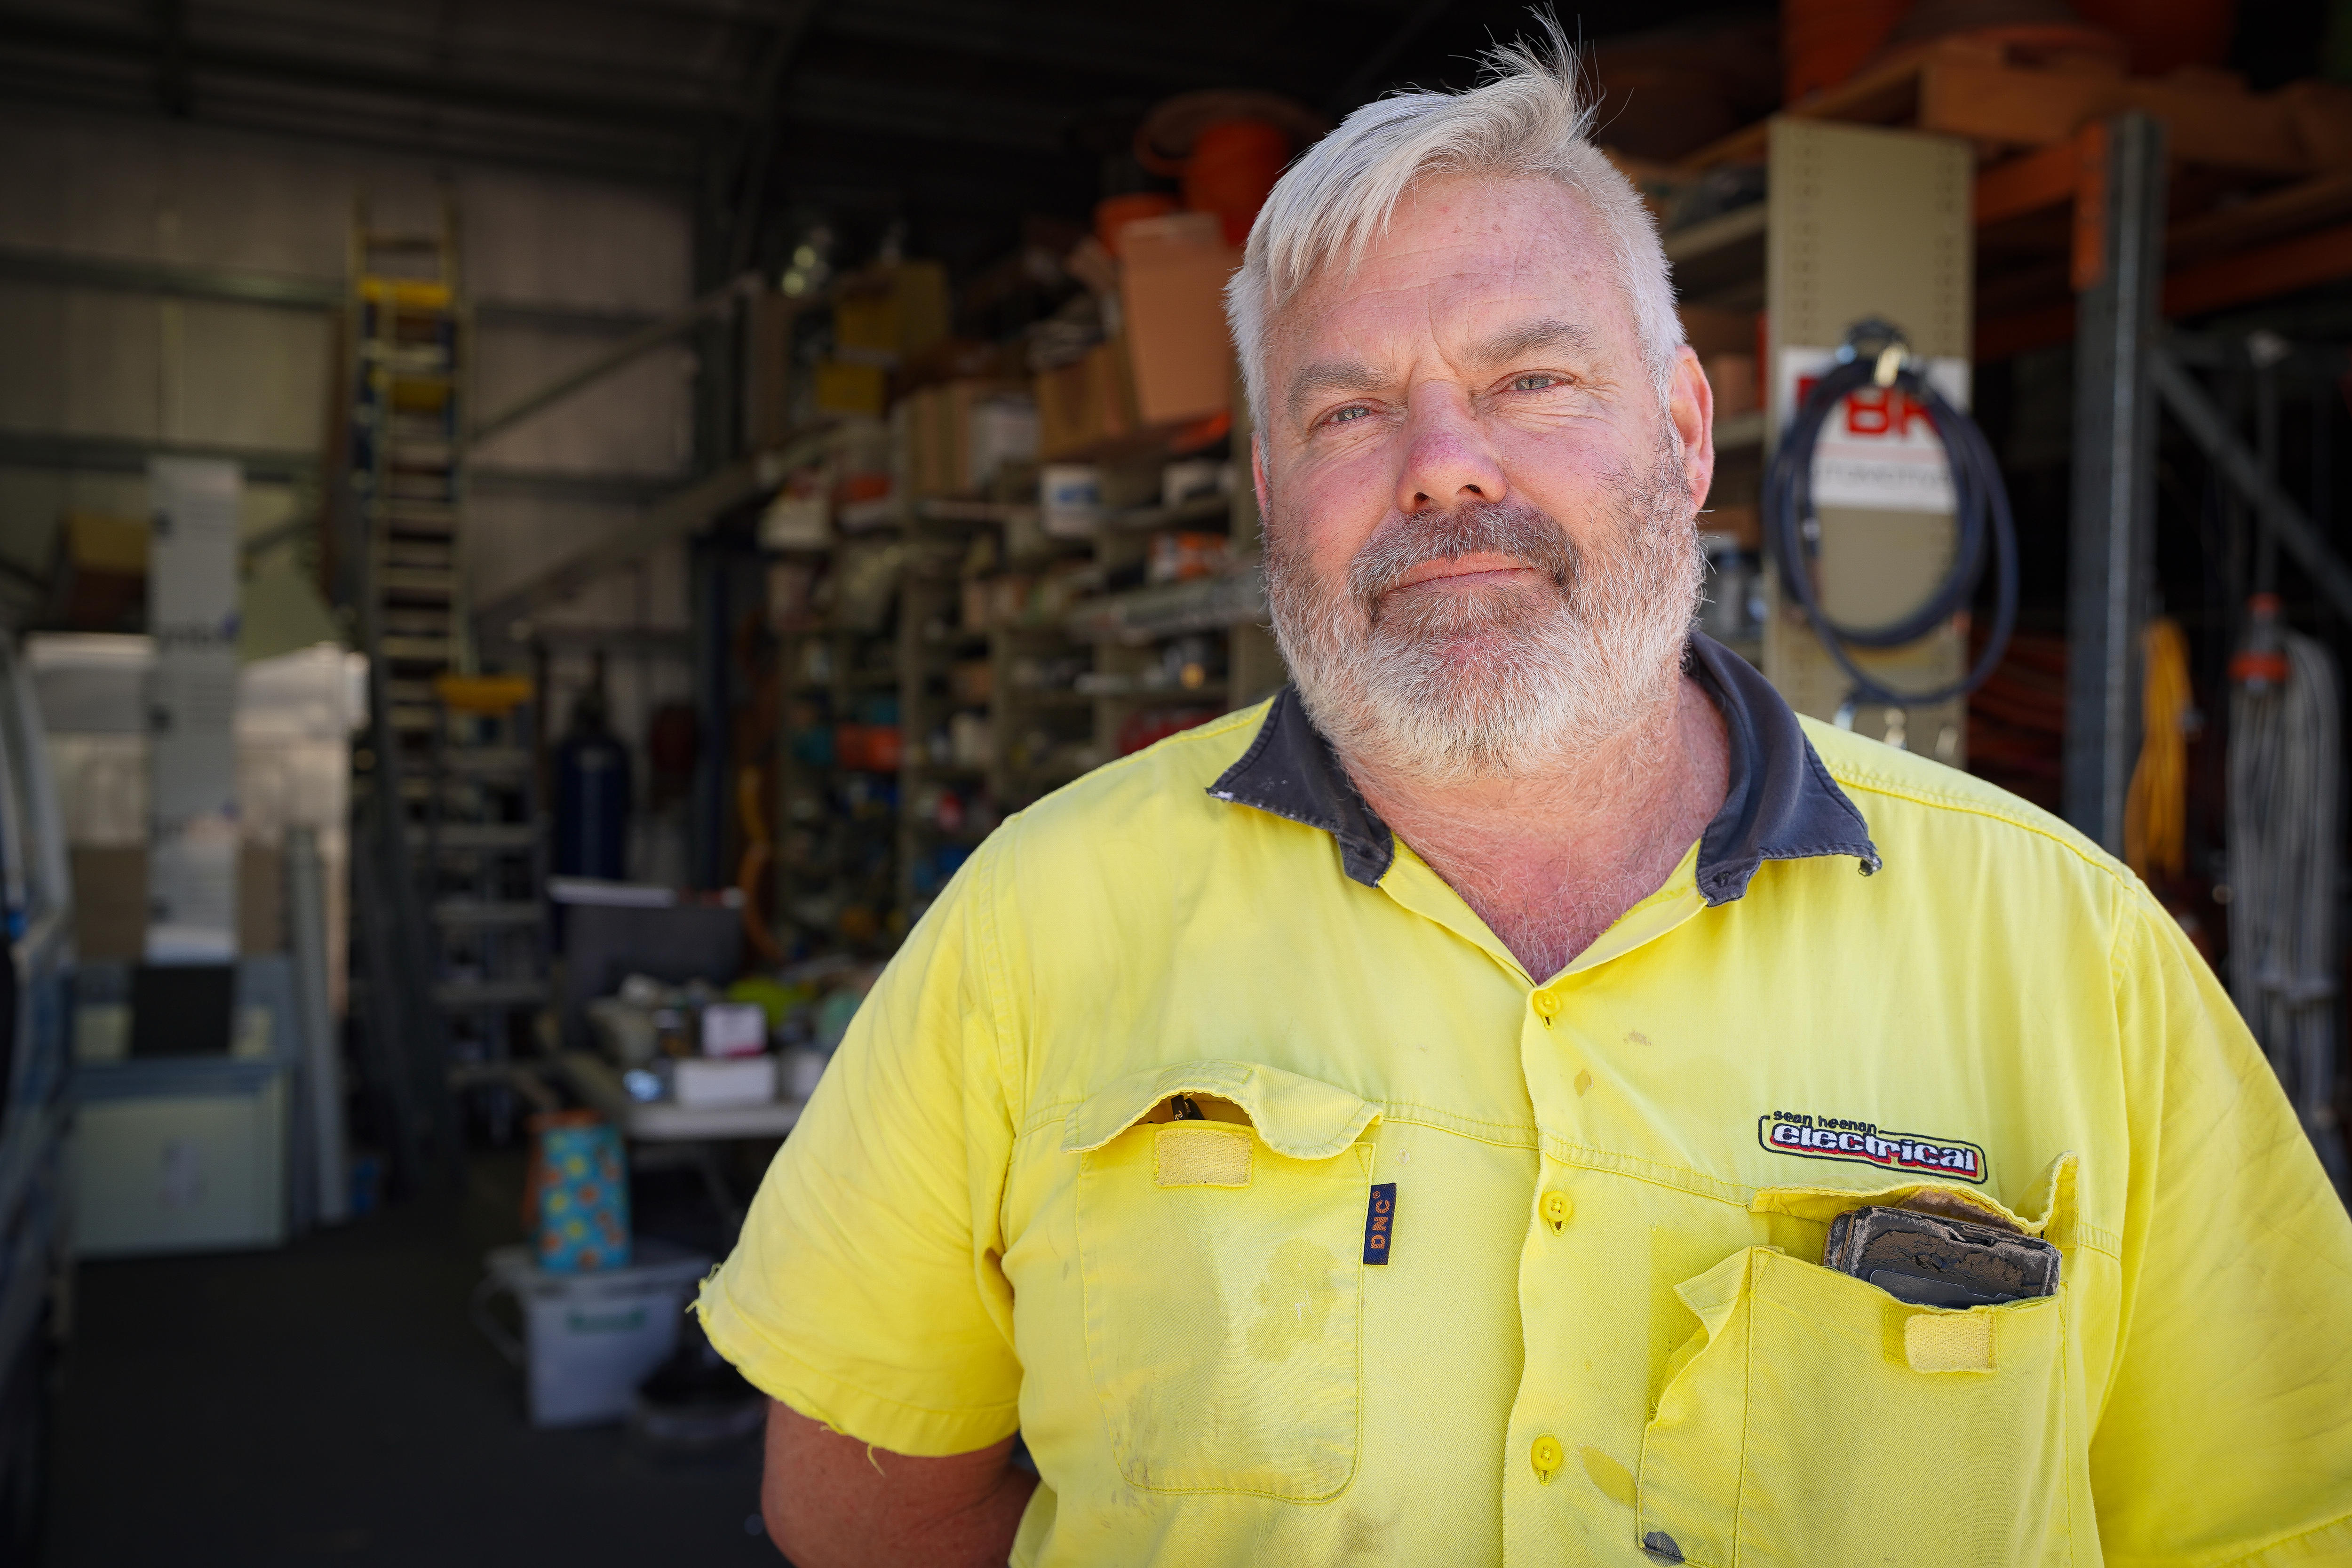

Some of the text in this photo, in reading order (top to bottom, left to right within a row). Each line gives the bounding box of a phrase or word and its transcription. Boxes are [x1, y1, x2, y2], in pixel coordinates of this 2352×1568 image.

[1773, 1110, 1877, 1134] sean heenan
[1770, 1123, 1978, 1177] electrical
